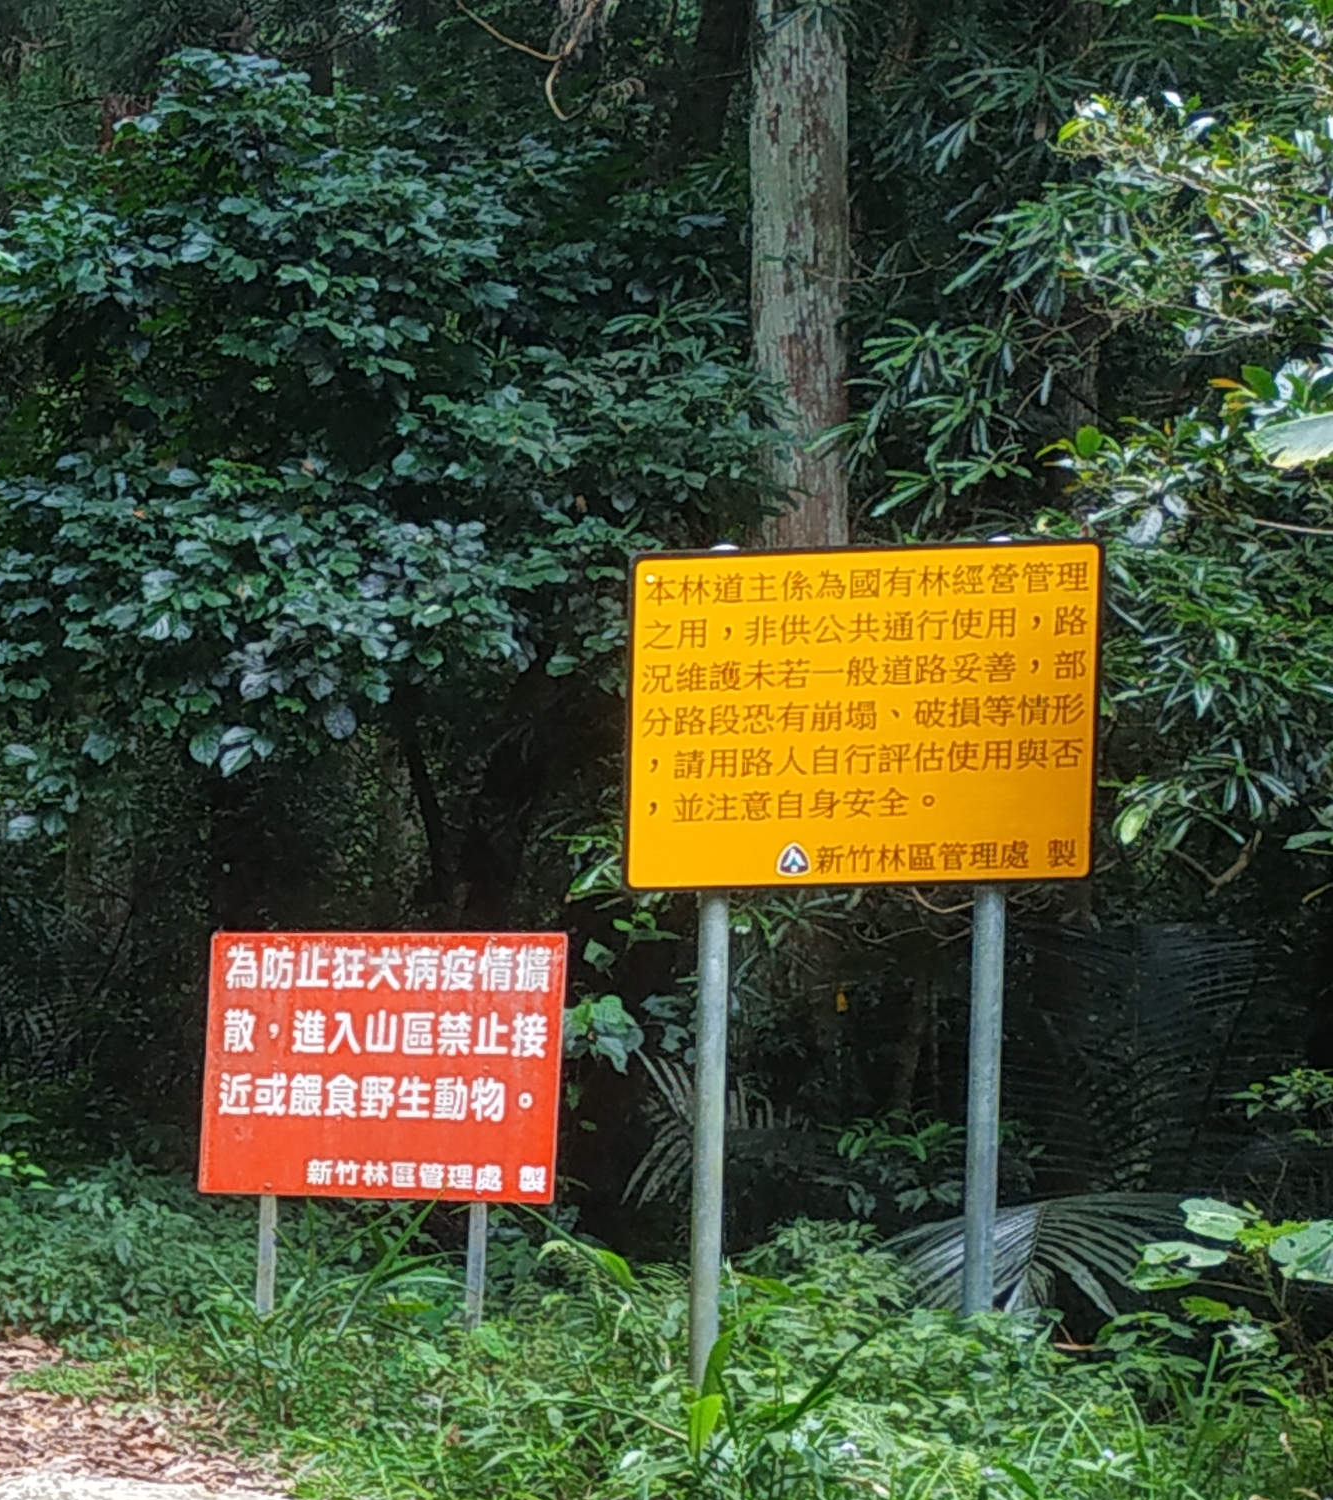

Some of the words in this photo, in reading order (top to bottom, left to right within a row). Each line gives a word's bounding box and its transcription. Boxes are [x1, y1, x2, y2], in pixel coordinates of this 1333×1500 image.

[645, 561, 1089, 607] 本林道主係為國有林經營管理
[642, 604, 1088, 650] 之用，非供公共通行使用，路
[641, 649, 1087, 695] 況維護未若一般道路妥善，部
[641, 692, 1086, 739] 分路段恐有崩塌、破損等情形
[648, 737, 1084, 780] ，請用路人自行評估使用與否
[647, 786, 937, 823] ，並注意自身安全。
[814, 839, 1030, 874] 新竹林區管理處
[1046, 838, 1077, 868] 製
[224, 944, 554, 993] 為防止狂犬病疫情擴
[222, 1008, 549, 1059] 散，進入山區禁止接
[217, 1072, 534, 1123] 近或餵食野生動物。
[306, 1157, 503, 1193] 新竹林區管理處
[518, 1165, 547, 1194] 製
